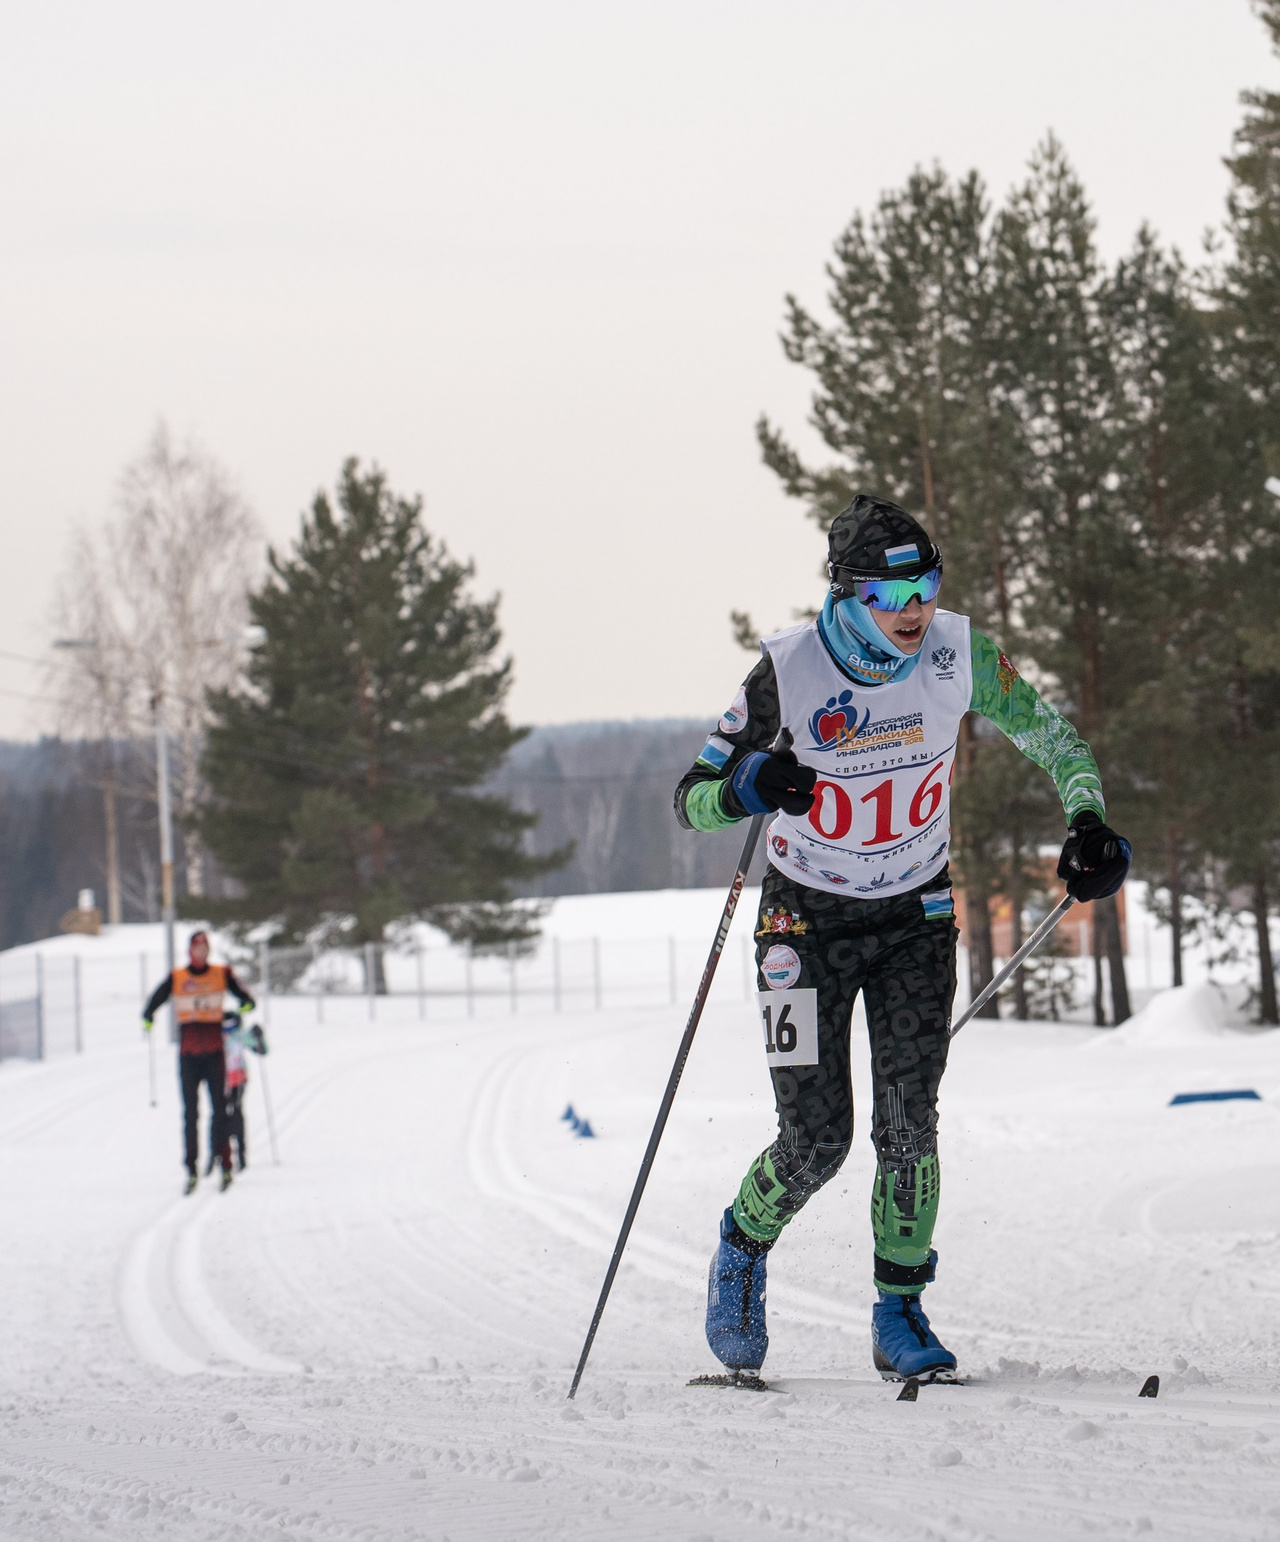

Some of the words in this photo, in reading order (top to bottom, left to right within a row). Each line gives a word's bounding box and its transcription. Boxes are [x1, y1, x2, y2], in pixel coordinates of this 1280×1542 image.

[836, 725, 857, 741] IV
[857, 718, 923, 739] ЗИМНЯЯ
[836, 726, 924, 748] СПАРТАКИАДА
[836, 741, 902, 757] ИНВАЛИДОВ
[835, 763, 875, 773] СПОРТ
[882, 757, 903, 766] ЭТО
[911, 752, 934, 761] МЫ!
[808, 761, 944, 846] 016
[882, 843, 913, 860] ЖИВИ
[762, 1004, 797, 1053] 16
